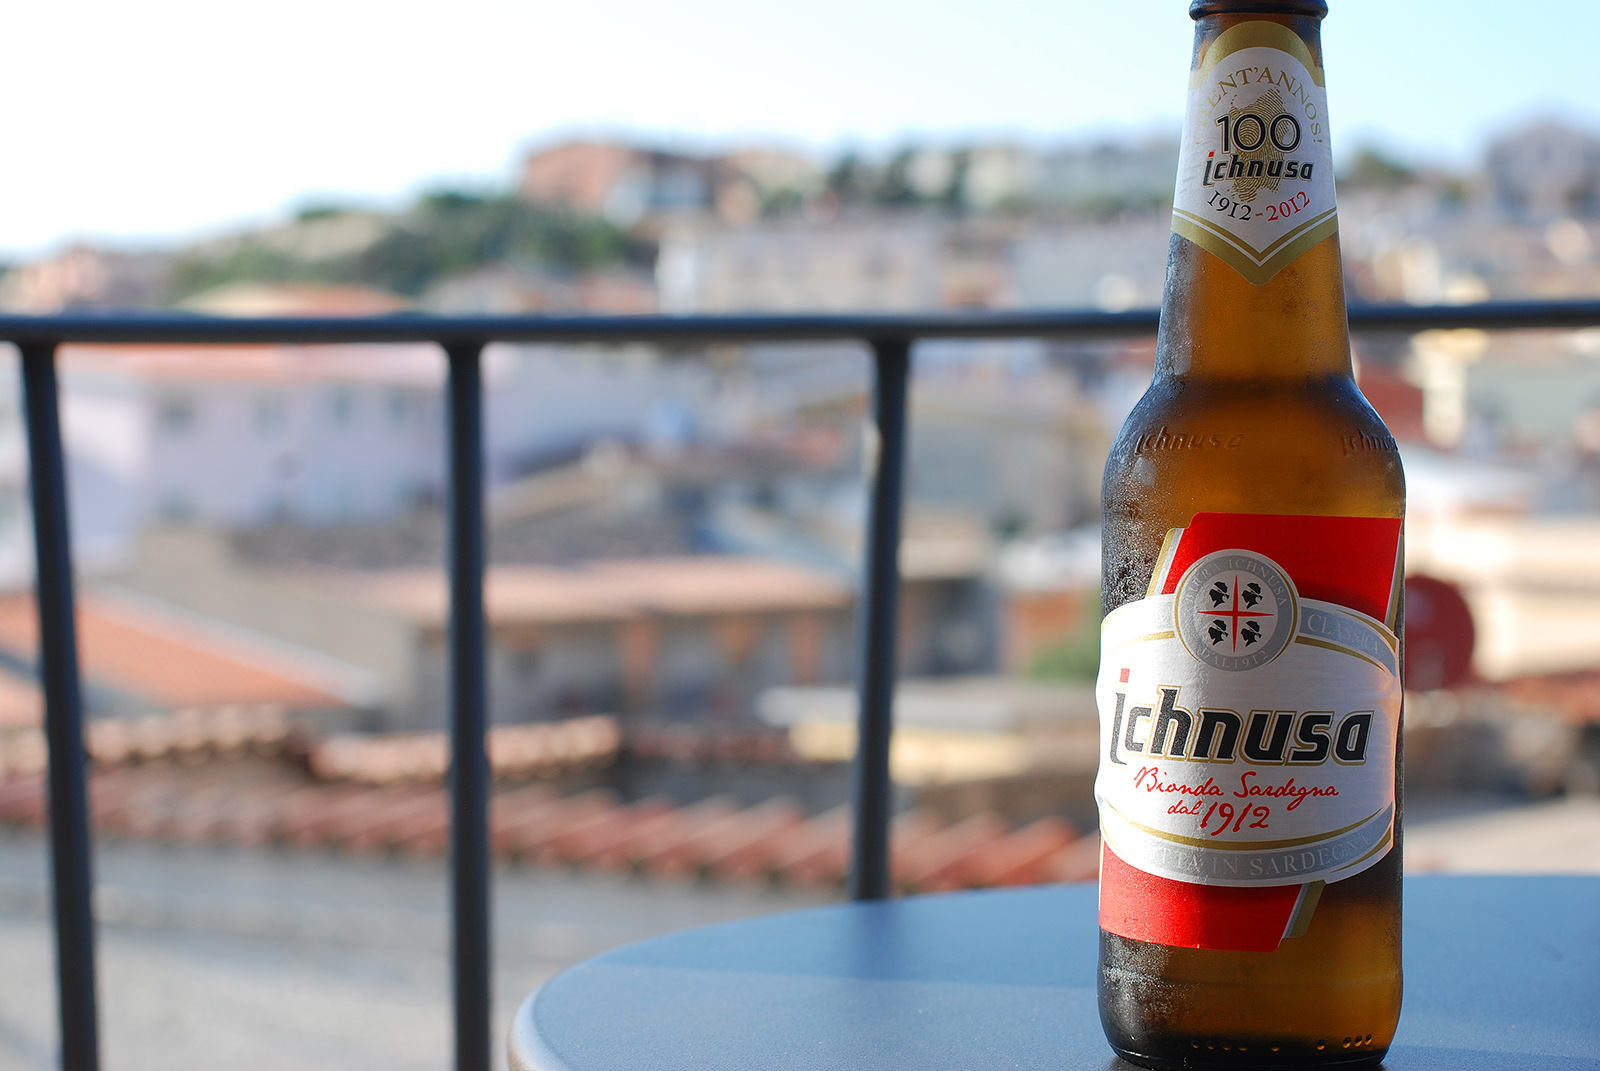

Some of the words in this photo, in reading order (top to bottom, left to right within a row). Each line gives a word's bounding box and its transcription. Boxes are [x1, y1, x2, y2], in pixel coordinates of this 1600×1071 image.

[1215, 113, 1303, 153] 100
[1202, 150, 1314, 188] ichnusa
[1228, 558, 1288, 607] ICHNUSA
[1108, 668, 1375, 767] ichnusa
[1133, 766, 1225, 796] Bionda
[1233, 771, 1340, 811] Sardegna
[1167, 800, 1203, 816] dal
[1199, 801, 1271, 836] 1912
[1212, 855, 1239, 876] IN
